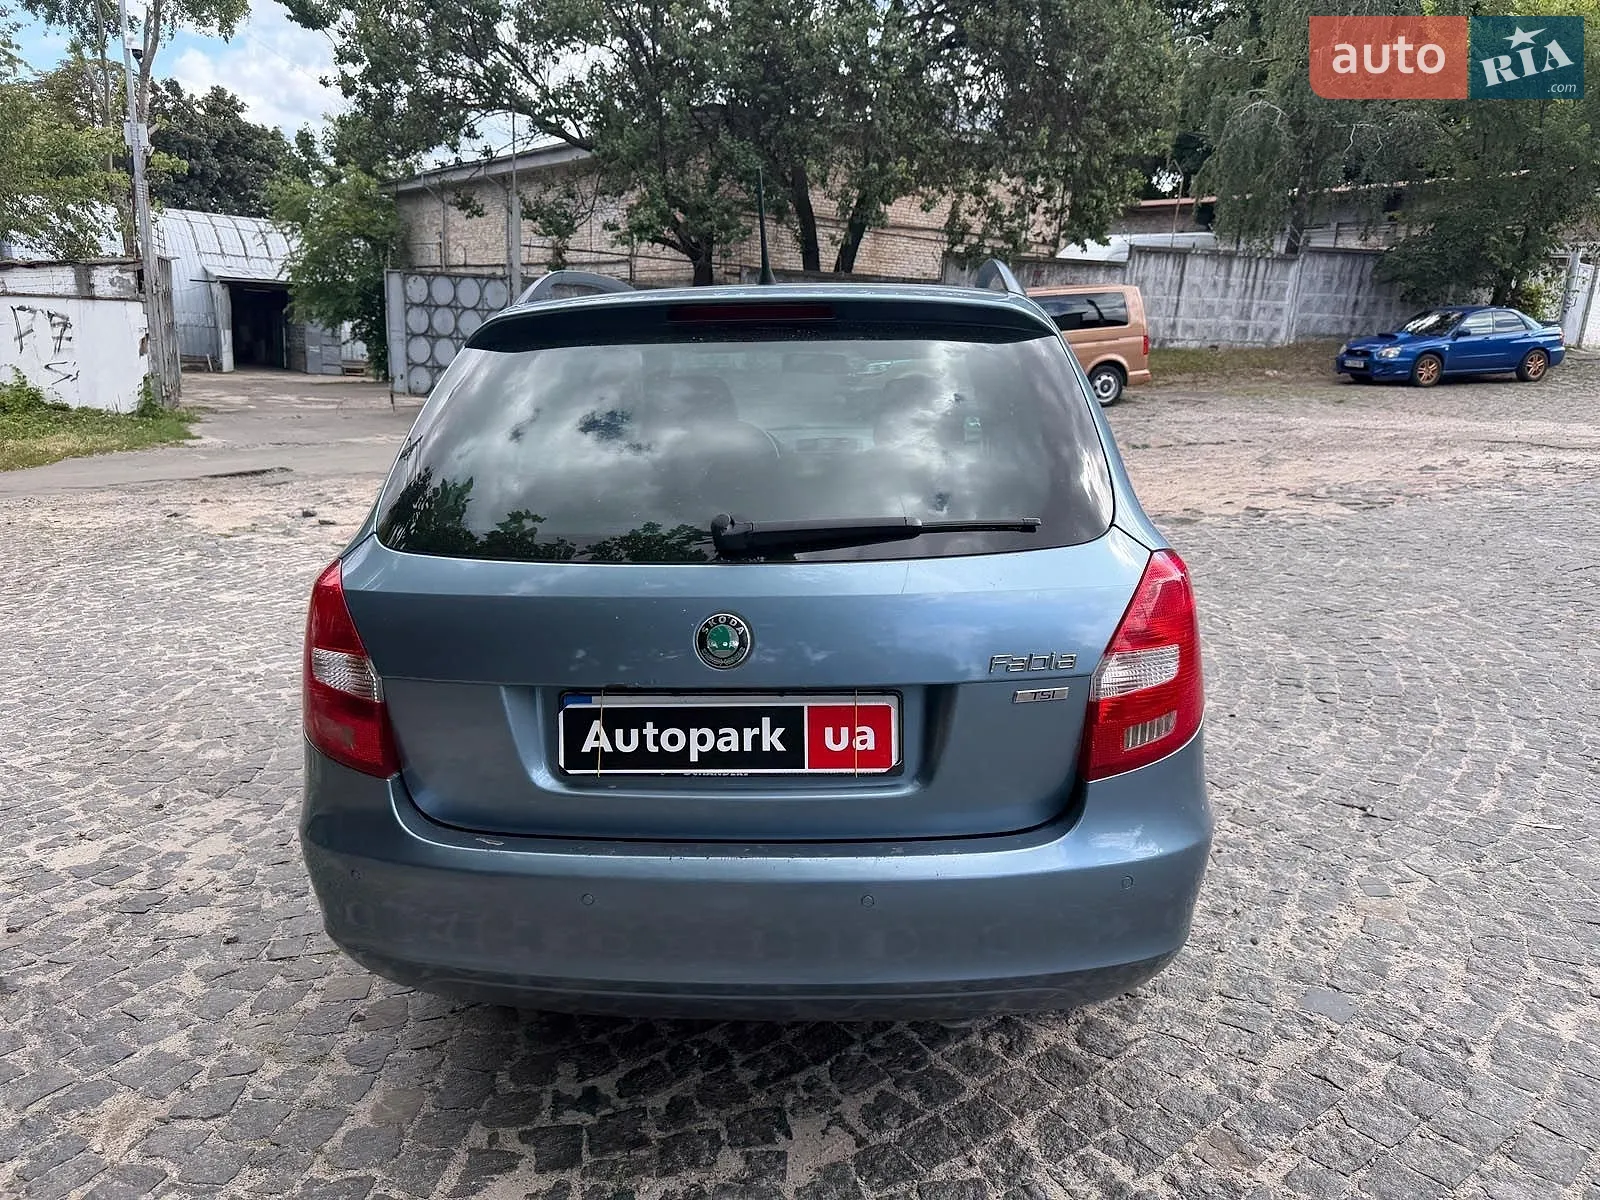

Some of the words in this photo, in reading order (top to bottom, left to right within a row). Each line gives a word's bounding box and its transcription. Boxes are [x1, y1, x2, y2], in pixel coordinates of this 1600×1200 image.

[989, 651, 1077, 673] Fabia
[1030, 690, 1056, 701] TSI
[580, 716, 787, 762] Autopark
[823, 725, 876, 752] ua
